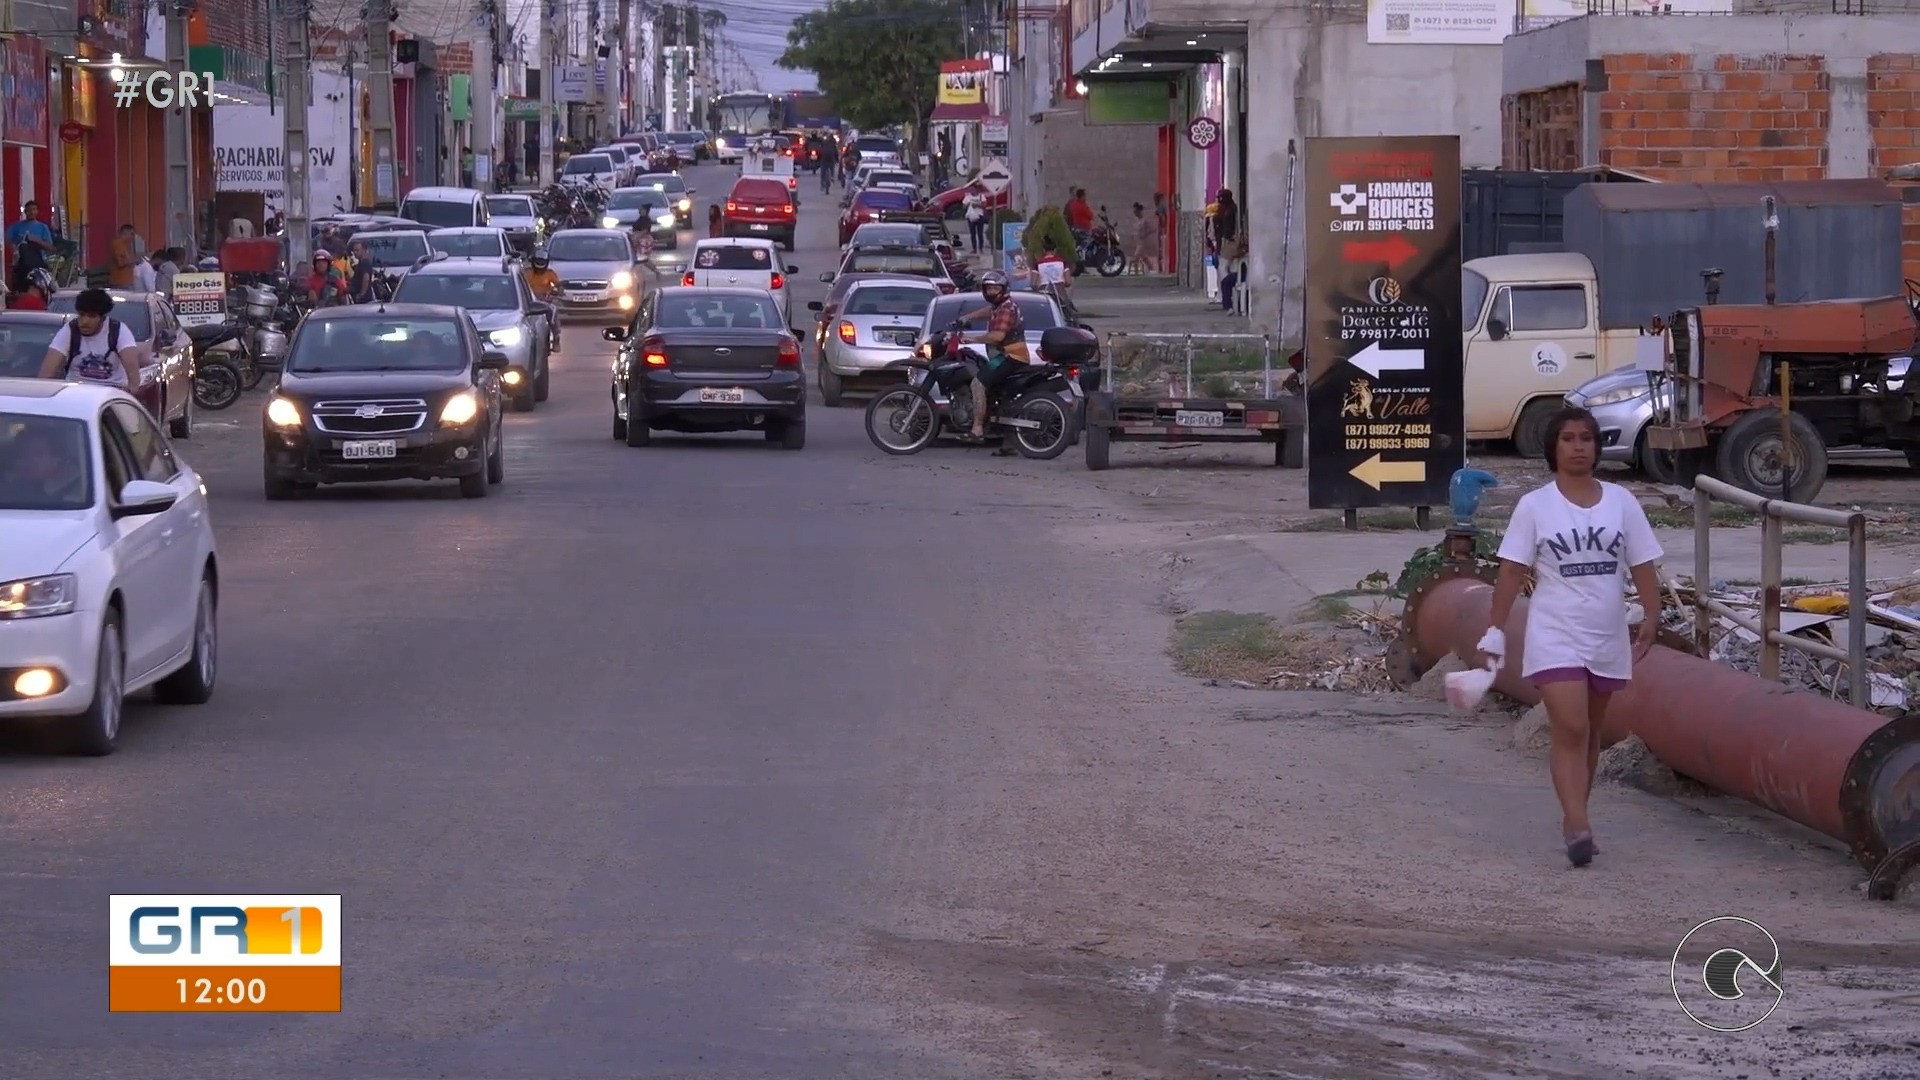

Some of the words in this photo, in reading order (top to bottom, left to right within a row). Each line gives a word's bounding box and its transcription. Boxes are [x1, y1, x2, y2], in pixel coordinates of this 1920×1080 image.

[1368, 179, 1433, 198] FARMÁCIA
[1368, 198, 1434, 219] BORGES
[1368, 219, 1434, 231] 99106-4013
[176, 281, 202, 289] Nego
[1341, 329, 1356, 339] 87
[1360, 328, 1430, 339] 99817-0011
[1345, 424, 1367, 436] (87)
[1369, 423, 1431, 435] 99927-4034
[1345, 438, 1367, 450] (87)
[1546, 526, 1624, 561] NIKE
[1562, 566, 1583, 576] JUST
[1585, 565, 1595, 574] DO
